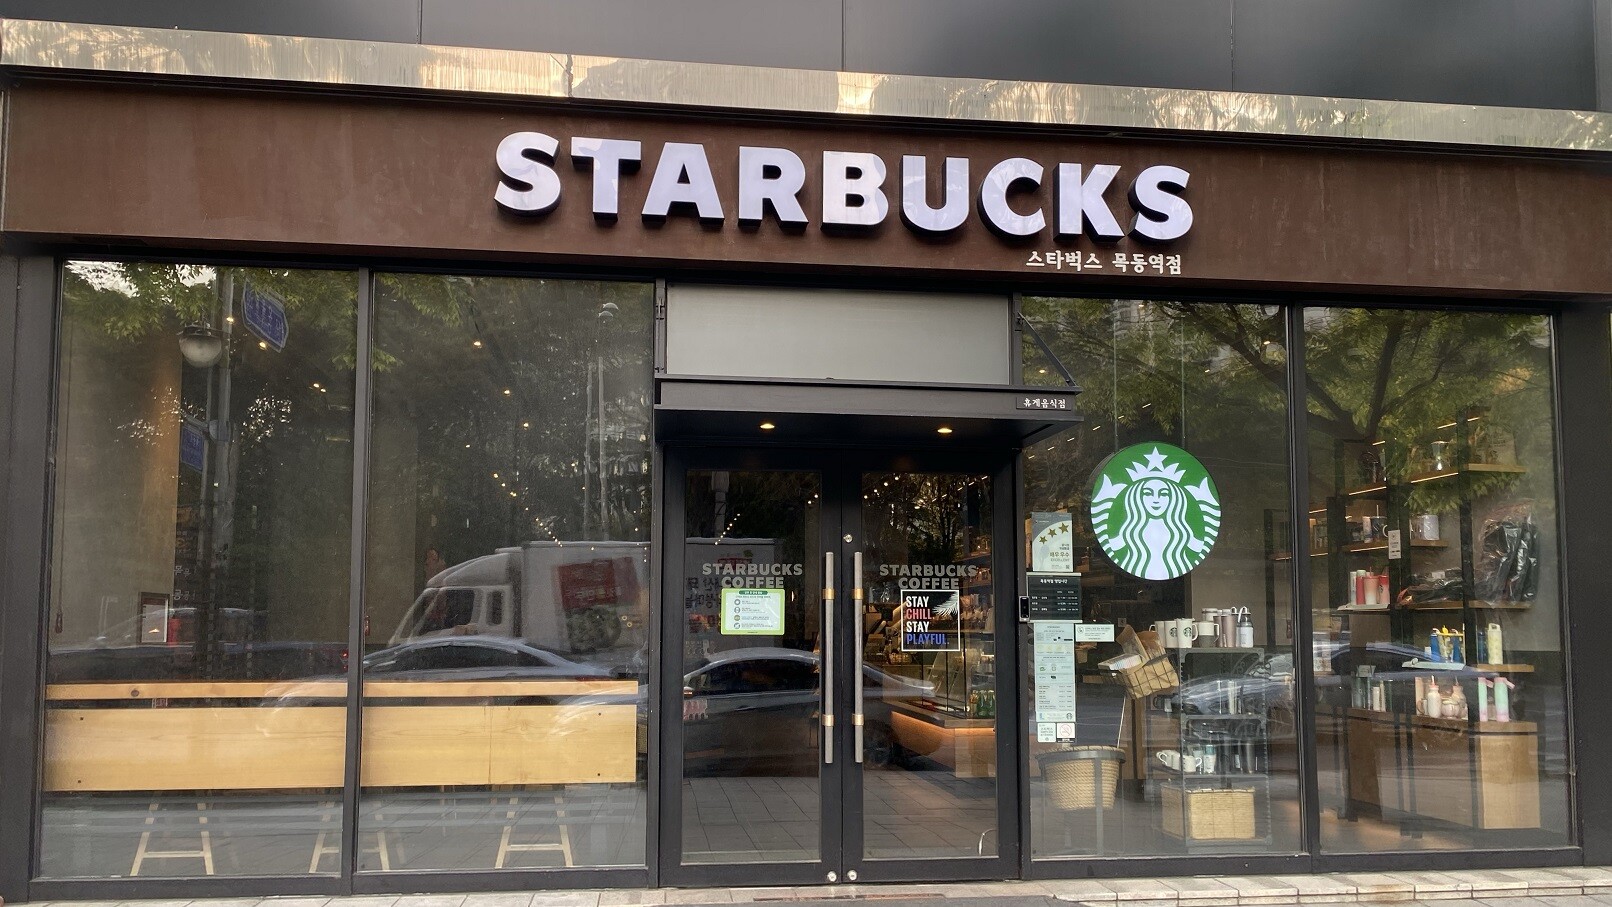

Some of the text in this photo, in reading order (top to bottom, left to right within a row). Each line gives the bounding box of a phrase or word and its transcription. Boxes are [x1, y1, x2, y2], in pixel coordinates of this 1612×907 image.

[494, 131, 1194, 243] STARBUCKS
[1026, 250, 1182, 275] 스타벅스 목동역점
[1023, 397, 1066, 409] 휴게음식점
[702, 563, 803, 576] STARBUCKS
[880, 564, 978, 577] STARBUCKS
[721, 576, 784, 589] COFFEE
[898, 577, 960, 590] COFFEE
[906, 596, 929, 608] STAY
[906, 608, 935, 620] CHILL.
[906, 621, 930, 633] STAY
[906, 633, 950, 645] PLAYFUL.
